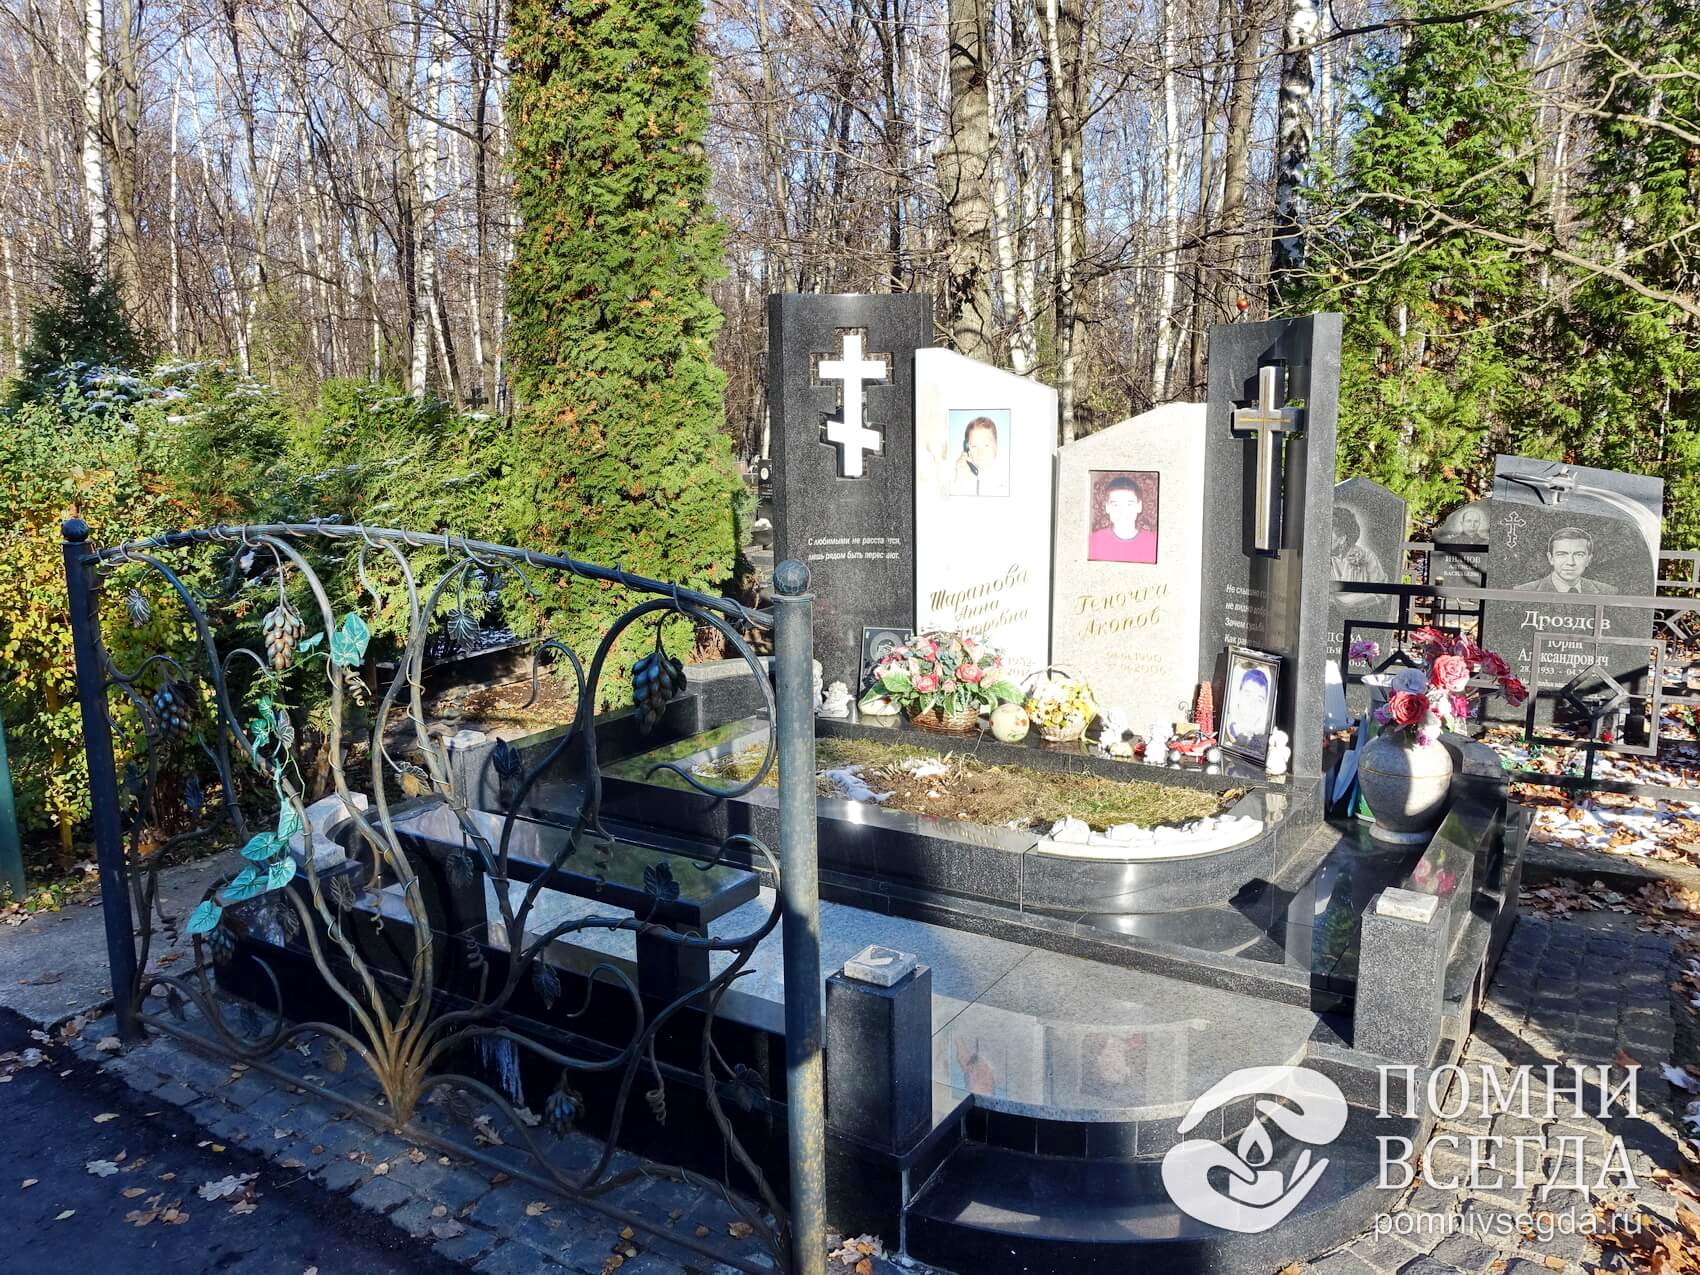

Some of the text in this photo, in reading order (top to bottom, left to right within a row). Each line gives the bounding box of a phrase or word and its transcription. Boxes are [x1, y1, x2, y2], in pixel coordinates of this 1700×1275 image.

[814, 535, 850, 545] любимыми
[852, 537, 861, 545] не
[808, 553, 824, 561] лишь
[825, 552, 846, 561] рядом
[847, 550, 863, 559] быть
[930, 563, 1028, 612] Шарапова
[1226, 583, 1235, 593] Не
[1072, 583, 1168, 615] Геночка
[955, 599, 999, 622] Анна
[1520, 610, 1611, 631] Дроздов
[1078, 606, 1161, 640] Акопов
